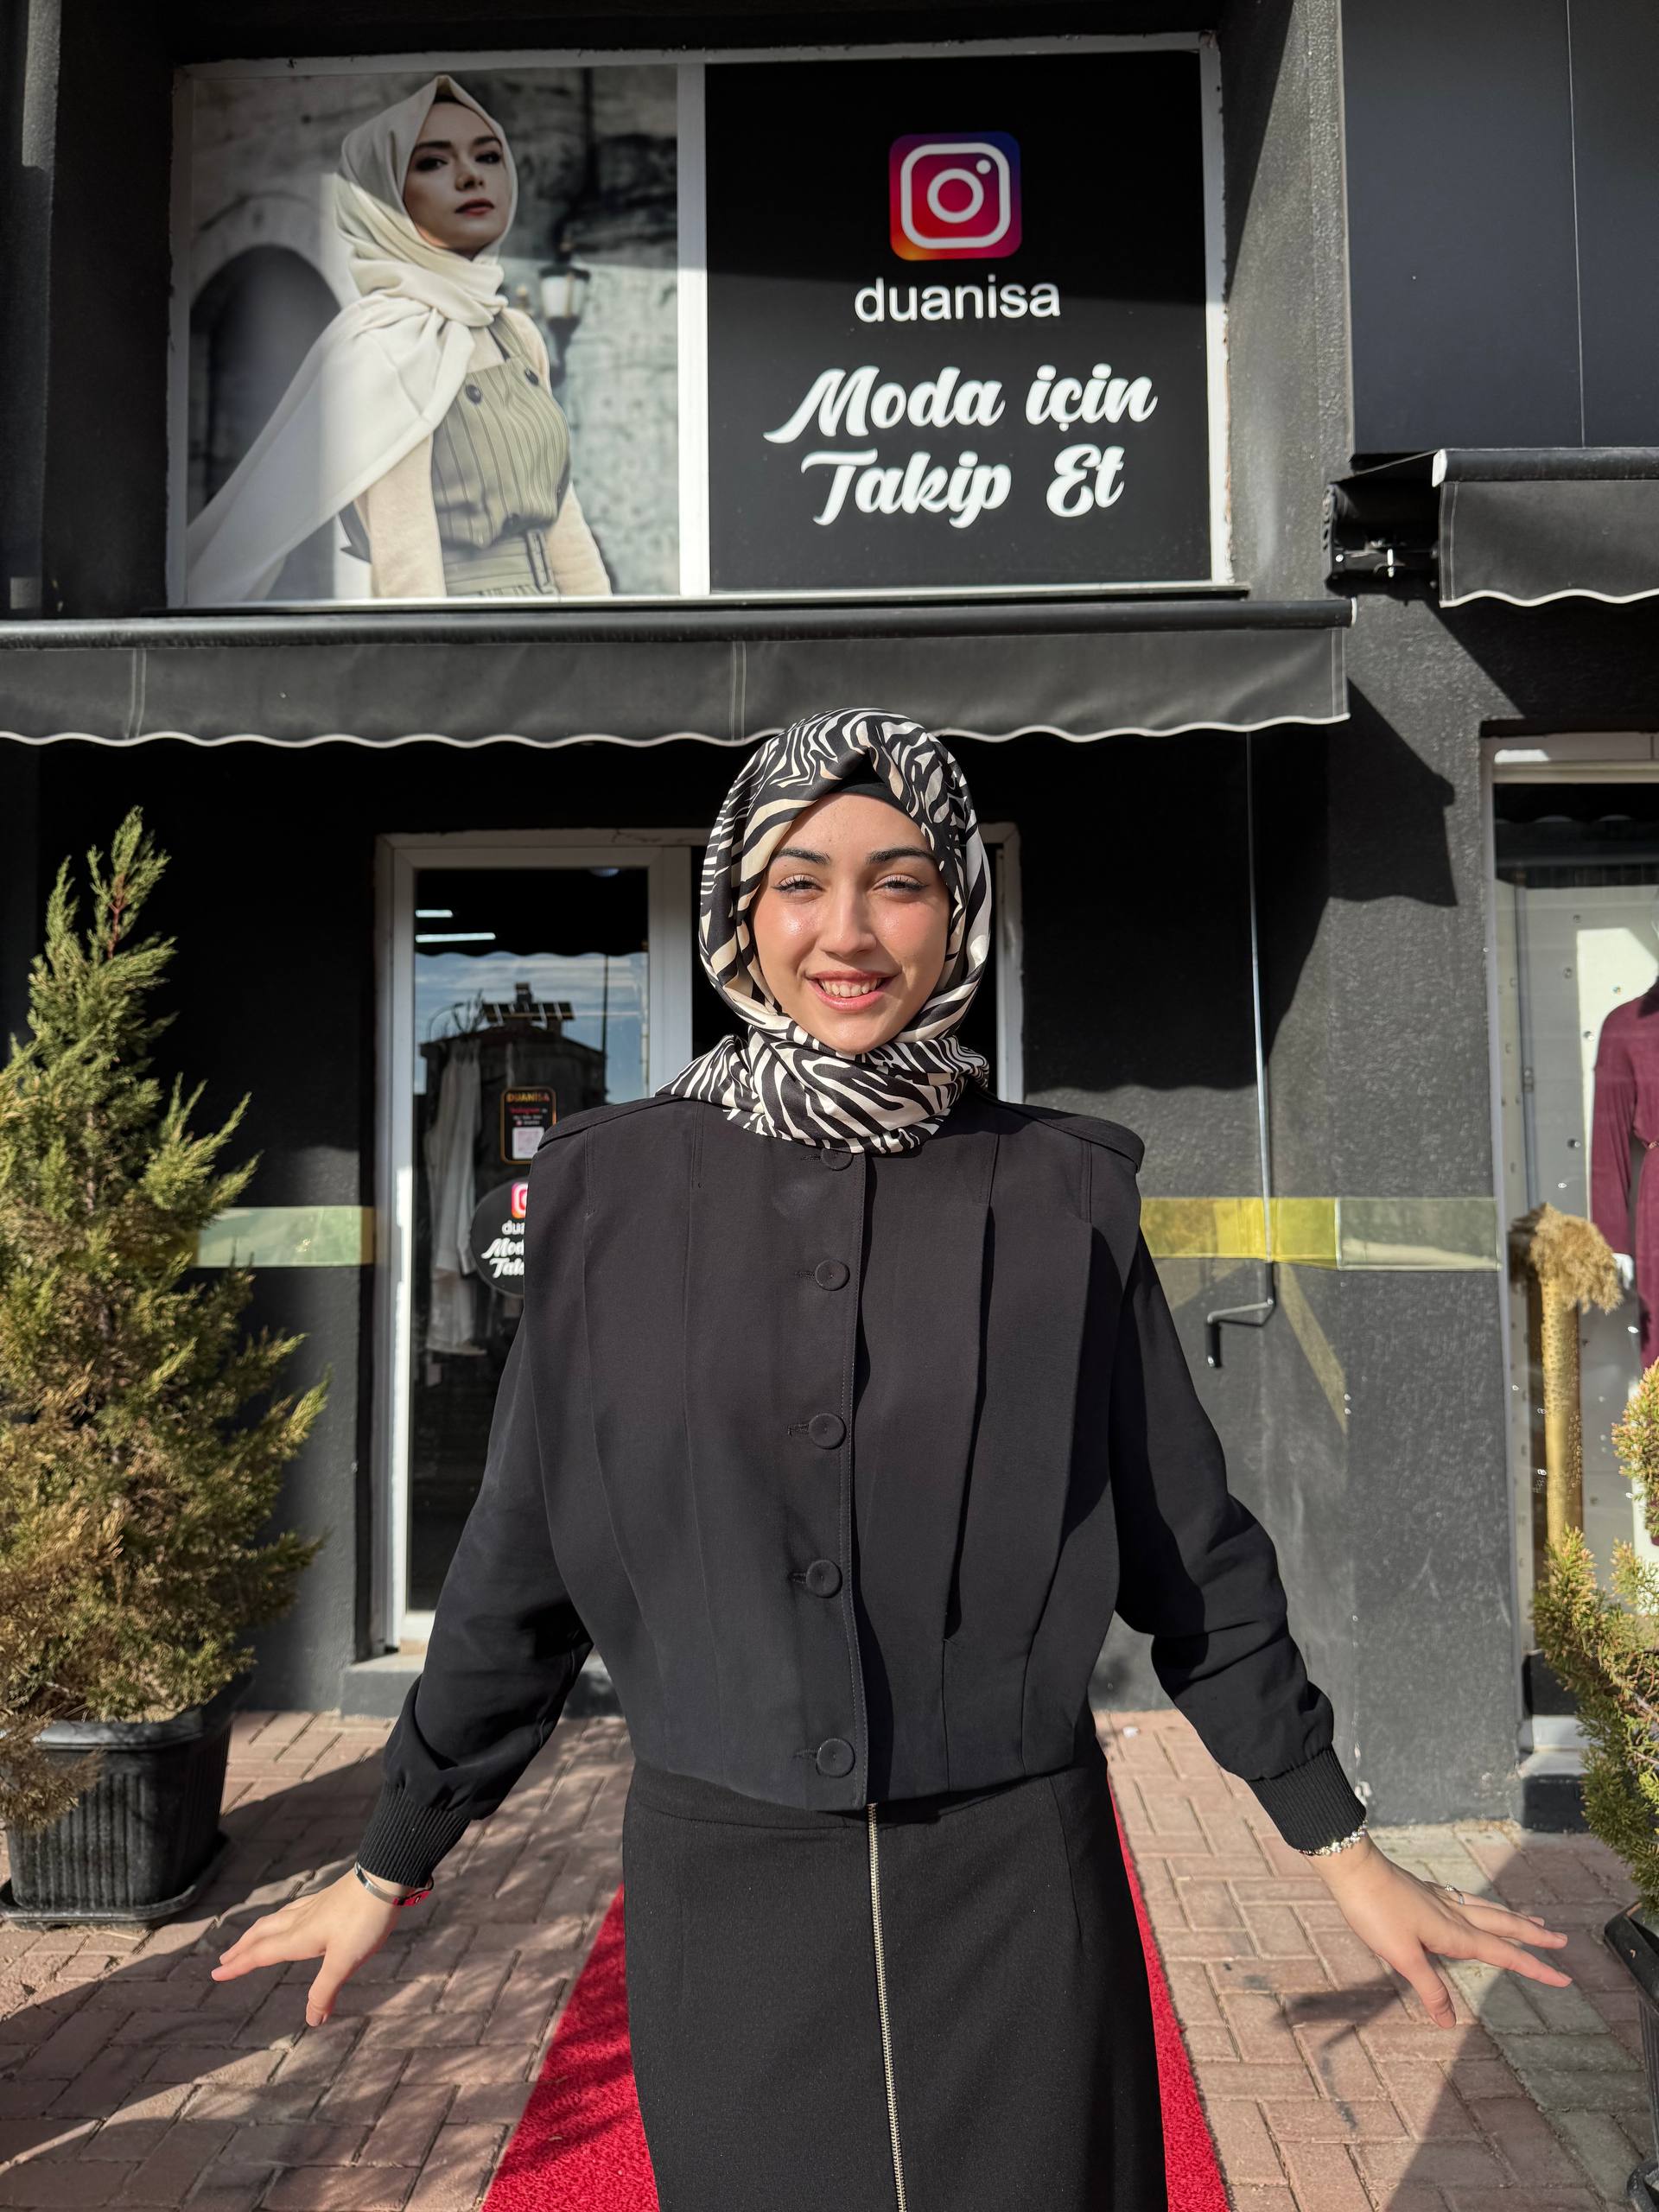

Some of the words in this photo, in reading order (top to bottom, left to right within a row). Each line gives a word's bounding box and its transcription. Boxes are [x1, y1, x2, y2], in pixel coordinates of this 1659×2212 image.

[854, 274, 1061, 322] duanisa
[763, 365, 1006, 443] Moda
[1025, 363, 1159, 432] için
[800, 448, 1012, 529] Takip
[1046, 443, 1125, 518] Et
